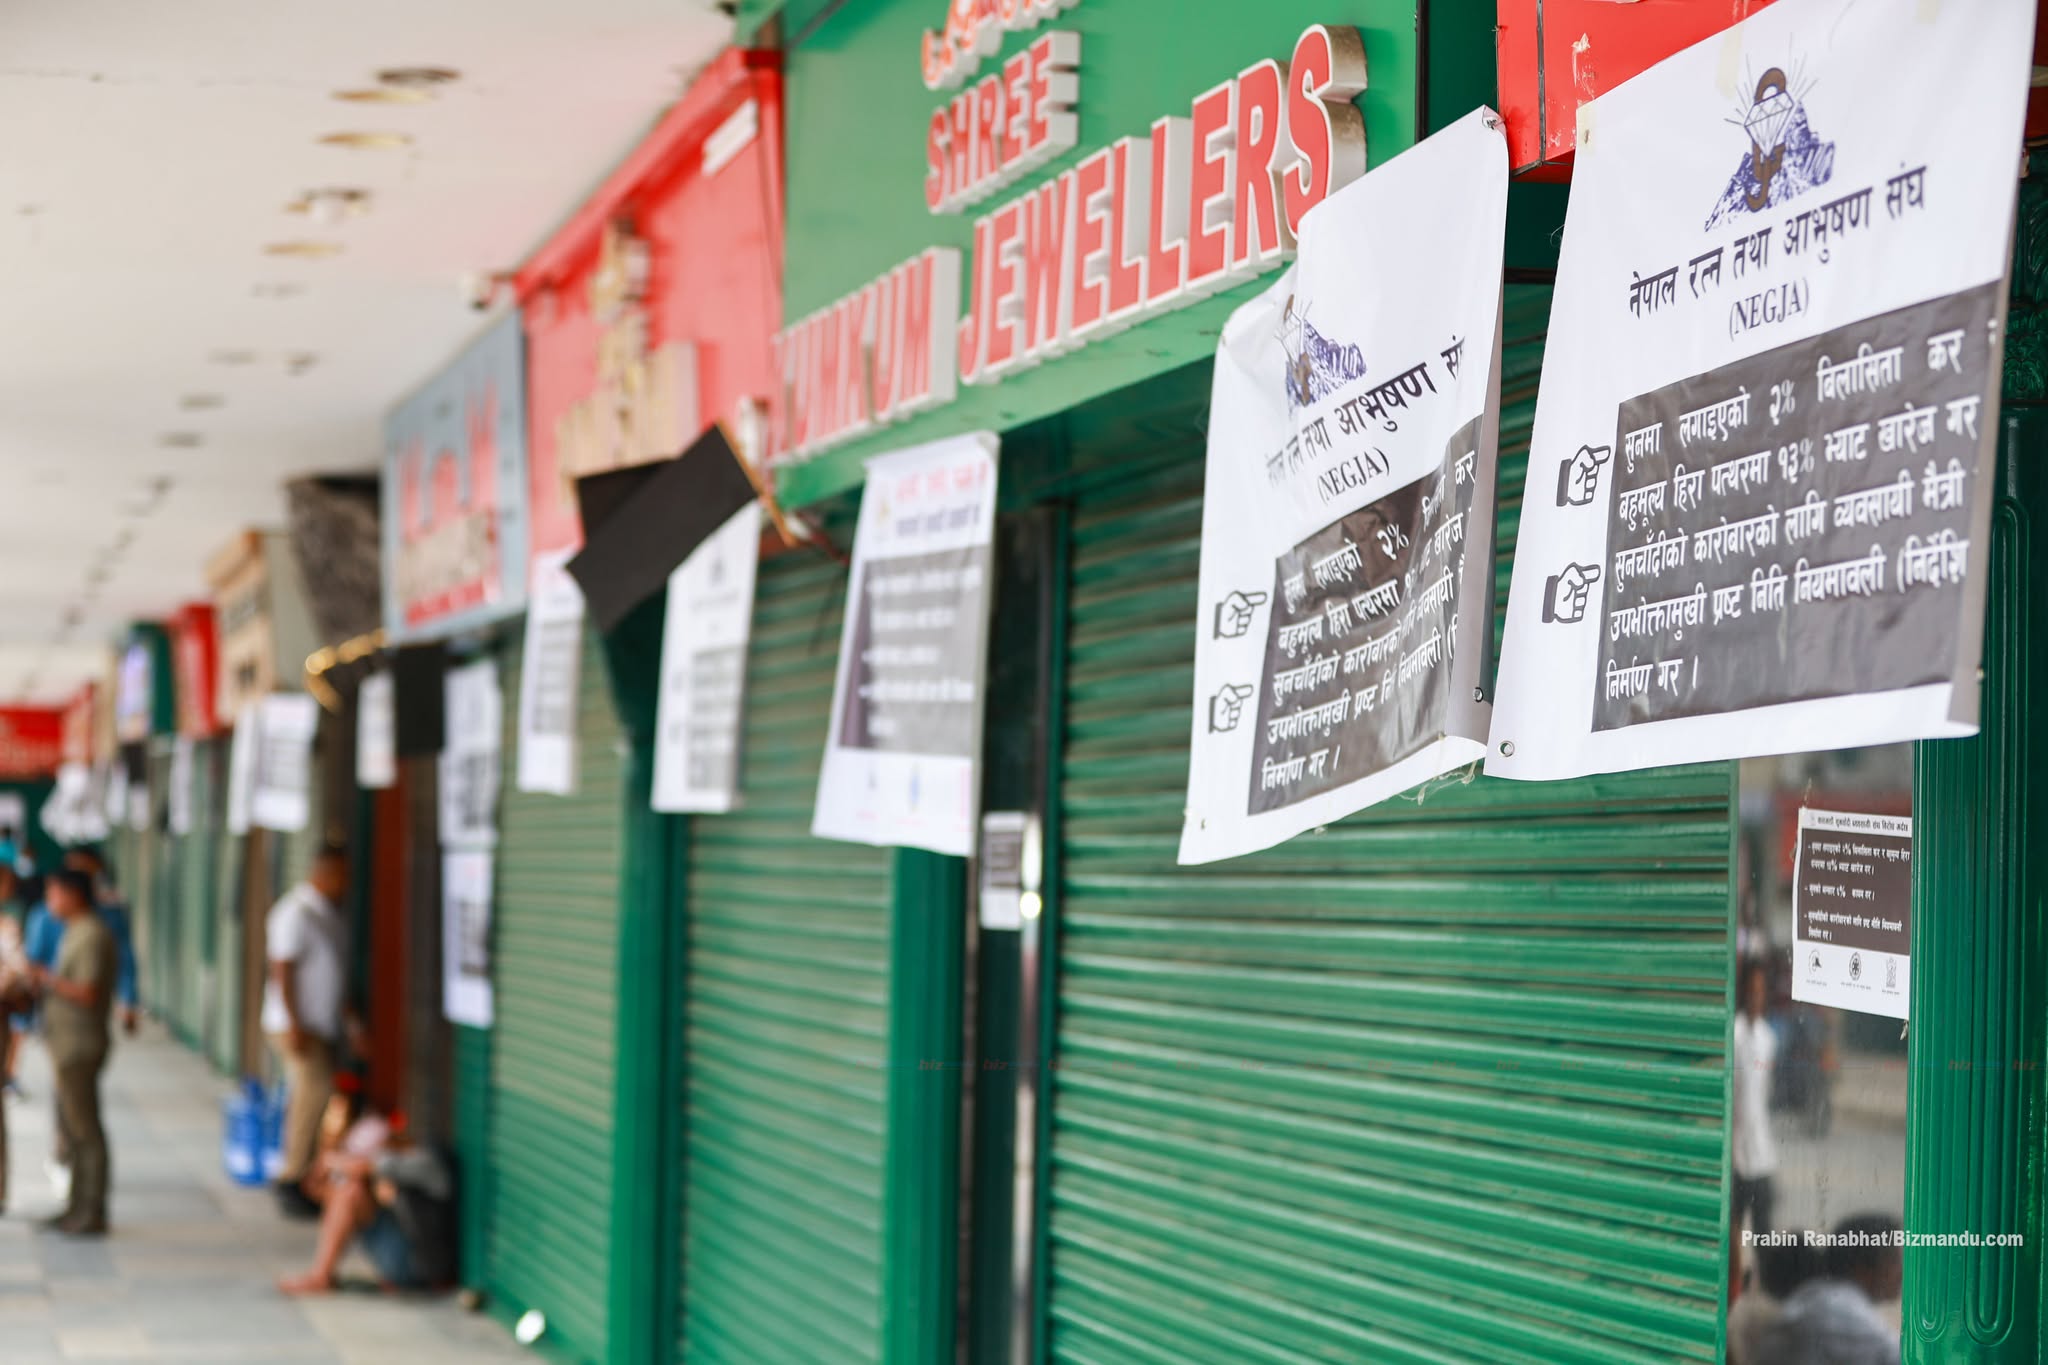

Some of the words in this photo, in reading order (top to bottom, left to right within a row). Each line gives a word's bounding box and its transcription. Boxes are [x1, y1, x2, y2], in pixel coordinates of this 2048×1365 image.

[925, 30, 1056, 214] SHREE
[958, 23, 1334, 384] JEWELLERS
[1630, 266, 1679, 319] नेपाल
[1689, 247, 1724, 299] रत्न
[1733, 227, 1772, 280] तथा
[1783, 187, 1873, 263] आभुषण
[1886, 162, 1927, 220] संघ
[1729, 277, 1809, 341] (NEGJA)
[1334, 361, 1438, 436] आभुषण
[1440, 334, 1466, 380] सं
[1625, 422, 1662, 474] सुनमा
[1679, 386, 1751, 447] लगाइएको
[1769, 379, 1795, 426] २%
[1816, 342, 1904, 403] विलासिता
[1927, 329, 1965, 374] कर
[1317, 447, 1390, 507] (NEGJA)
[1615, 527, 1688, 593] सुनचाँदीको
[1694, 504, 1780, 564] कारोबारको
[1785, 489, 1828, 545] लागि
[1833, 469, 1915, 527] व्यवसायी
[1922, 457, 1966, 510] मैत्री
[1619, 481, 1667, 531] बहुमूल्य
[1673, 463, 1706, 512] हिरा
[1711, 450, 1772, 495] पत्थरमा
[1777, 438, 1815, 484] १३%
[1824, 423, 1870, 463] भ्याट
[1376, 523, 1409, 560] २%
[1610, 581, 1707, 641] उपभोक्तामुखी
[1750, 562, 1788, 614] निति
[1793, 543, 1887, 605] नियमावली
[1605, 656, 1654, 701] निर्माण
[1657, 658, 1683, 696] गर
[1308, 748, 1330, 779] गर
